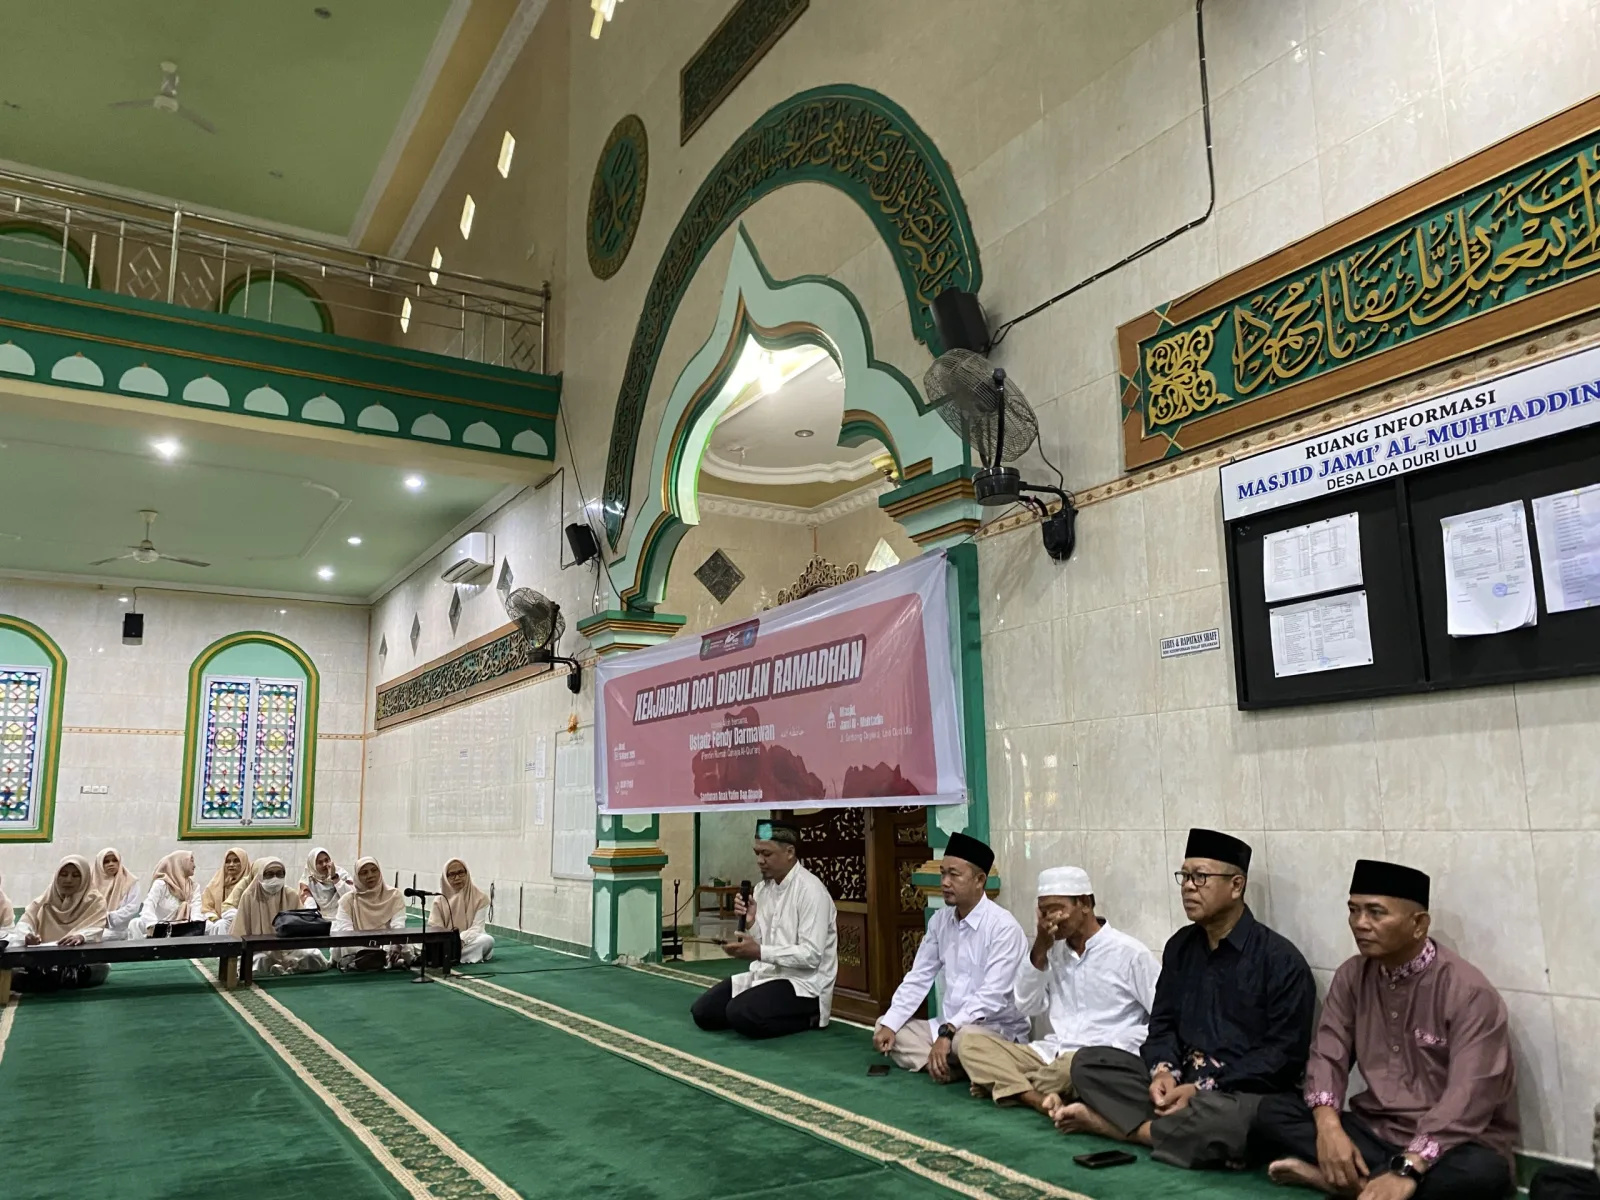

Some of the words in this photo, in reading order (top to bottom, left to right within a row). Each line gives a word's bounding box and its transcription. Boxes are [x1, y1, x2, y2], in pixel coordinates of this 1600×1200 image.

[1237, 466, 1313, 501] MASJID
[1386, 379, 1600, 459] AL-MUHTADDIN
[1305, 429, 1369, 460] RUANG
[1374, 389, 1497, 444] INFORMASI
[1327, 473, 1365, 491] DESA
[1368, 462, 1399, 481] LOA
[1403, 449, 1440, 470] DURI
[1444, 439, 1478, 459] ULU
[634, 682, 689, 722] KEAJAIBAN
[691, 675, 714, 712] DOA
[717, 661, 771, 706] DIBULAN
[773, 639, 864, 695] RAMADHAN
[689, 733, 711, 751] Ustadz
[712, 727, 733, 749] Fendy
[734, 723, 775, 746] Darmawan
